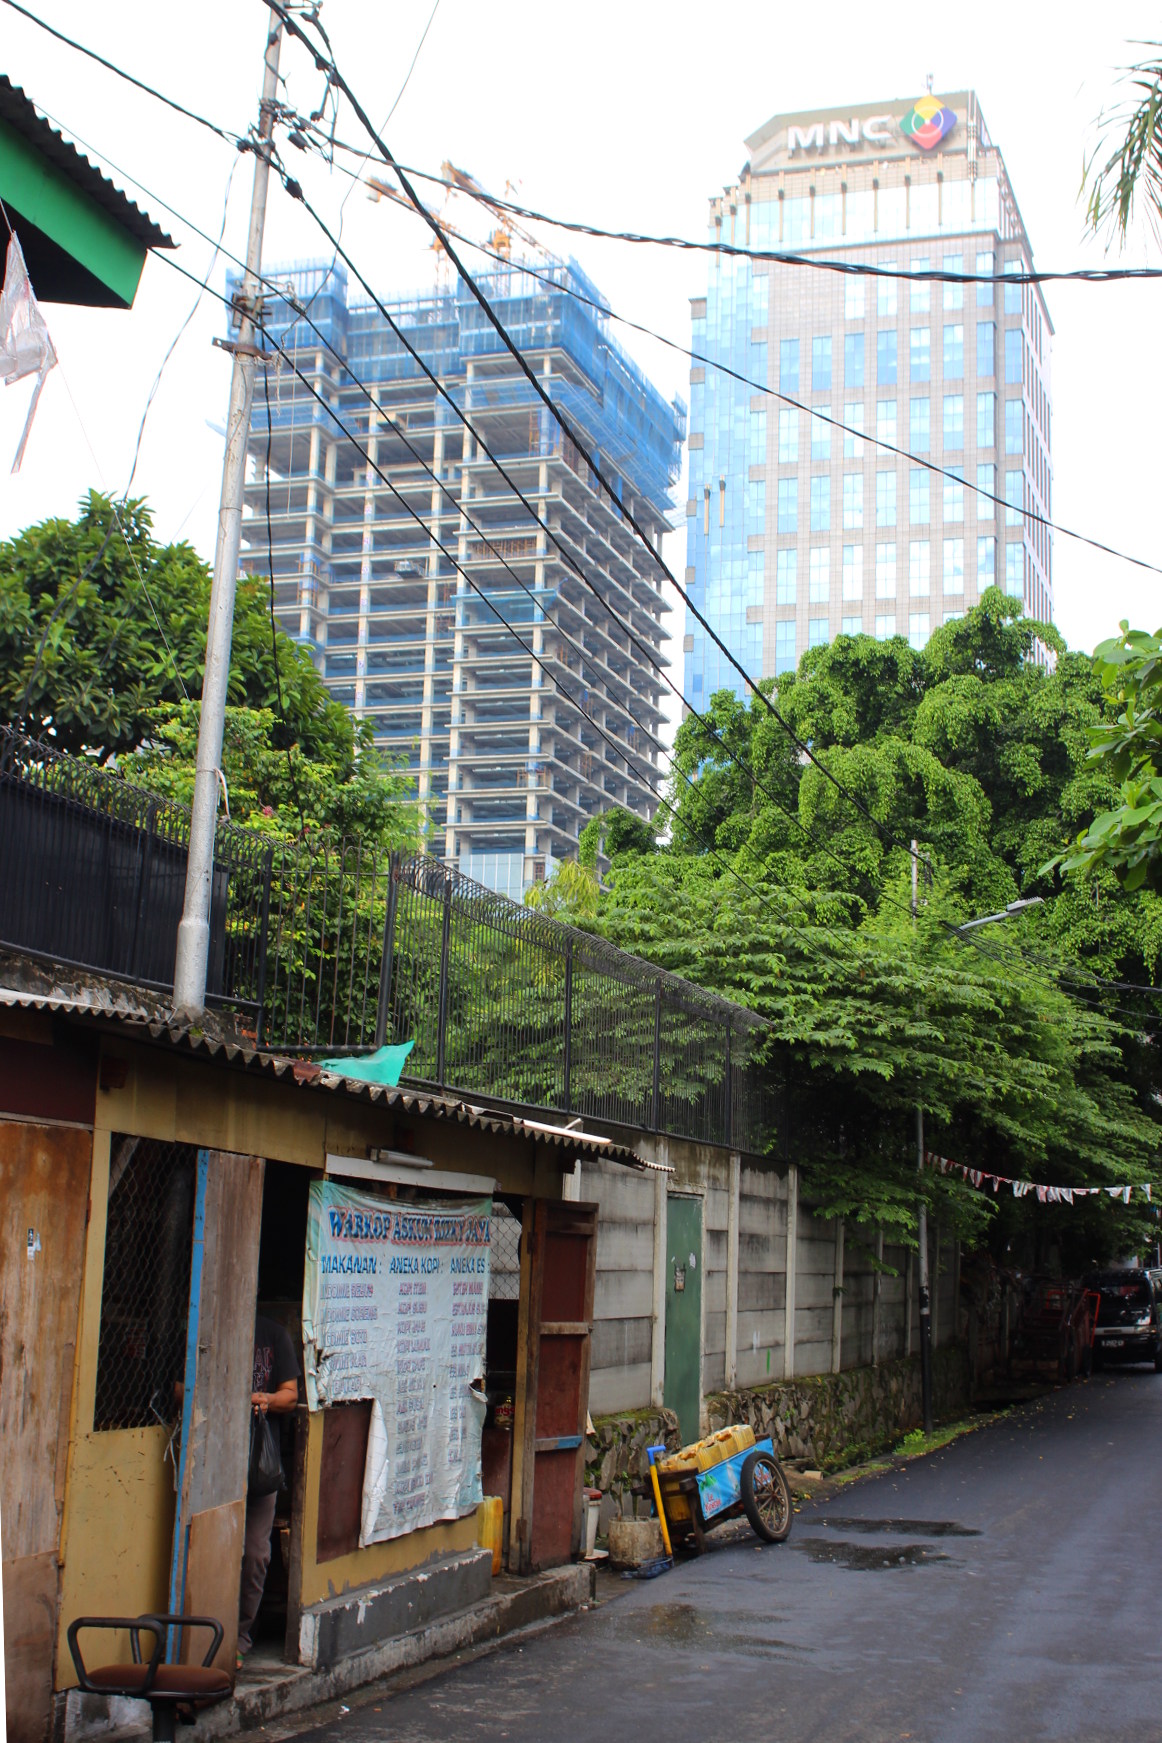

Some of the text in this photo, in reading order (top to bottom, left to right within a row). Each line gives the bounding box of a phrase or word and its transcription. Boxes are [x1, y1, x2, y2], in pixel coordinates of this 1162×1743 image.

[787, 115, 893, 150] MNC
[328, 1207, 391, 1242] WARKOP
[465, 1215, 491, 1244] JAYA
[321, 1254, 377, 1274] MAKANAN
[389, 1255, 419, 1274] ANEKA
[420, 1257, 440, 1274] KOPI
[450, 1257, 475, 1274] ANEKA
[476, 1257, 485, 1274] ES
